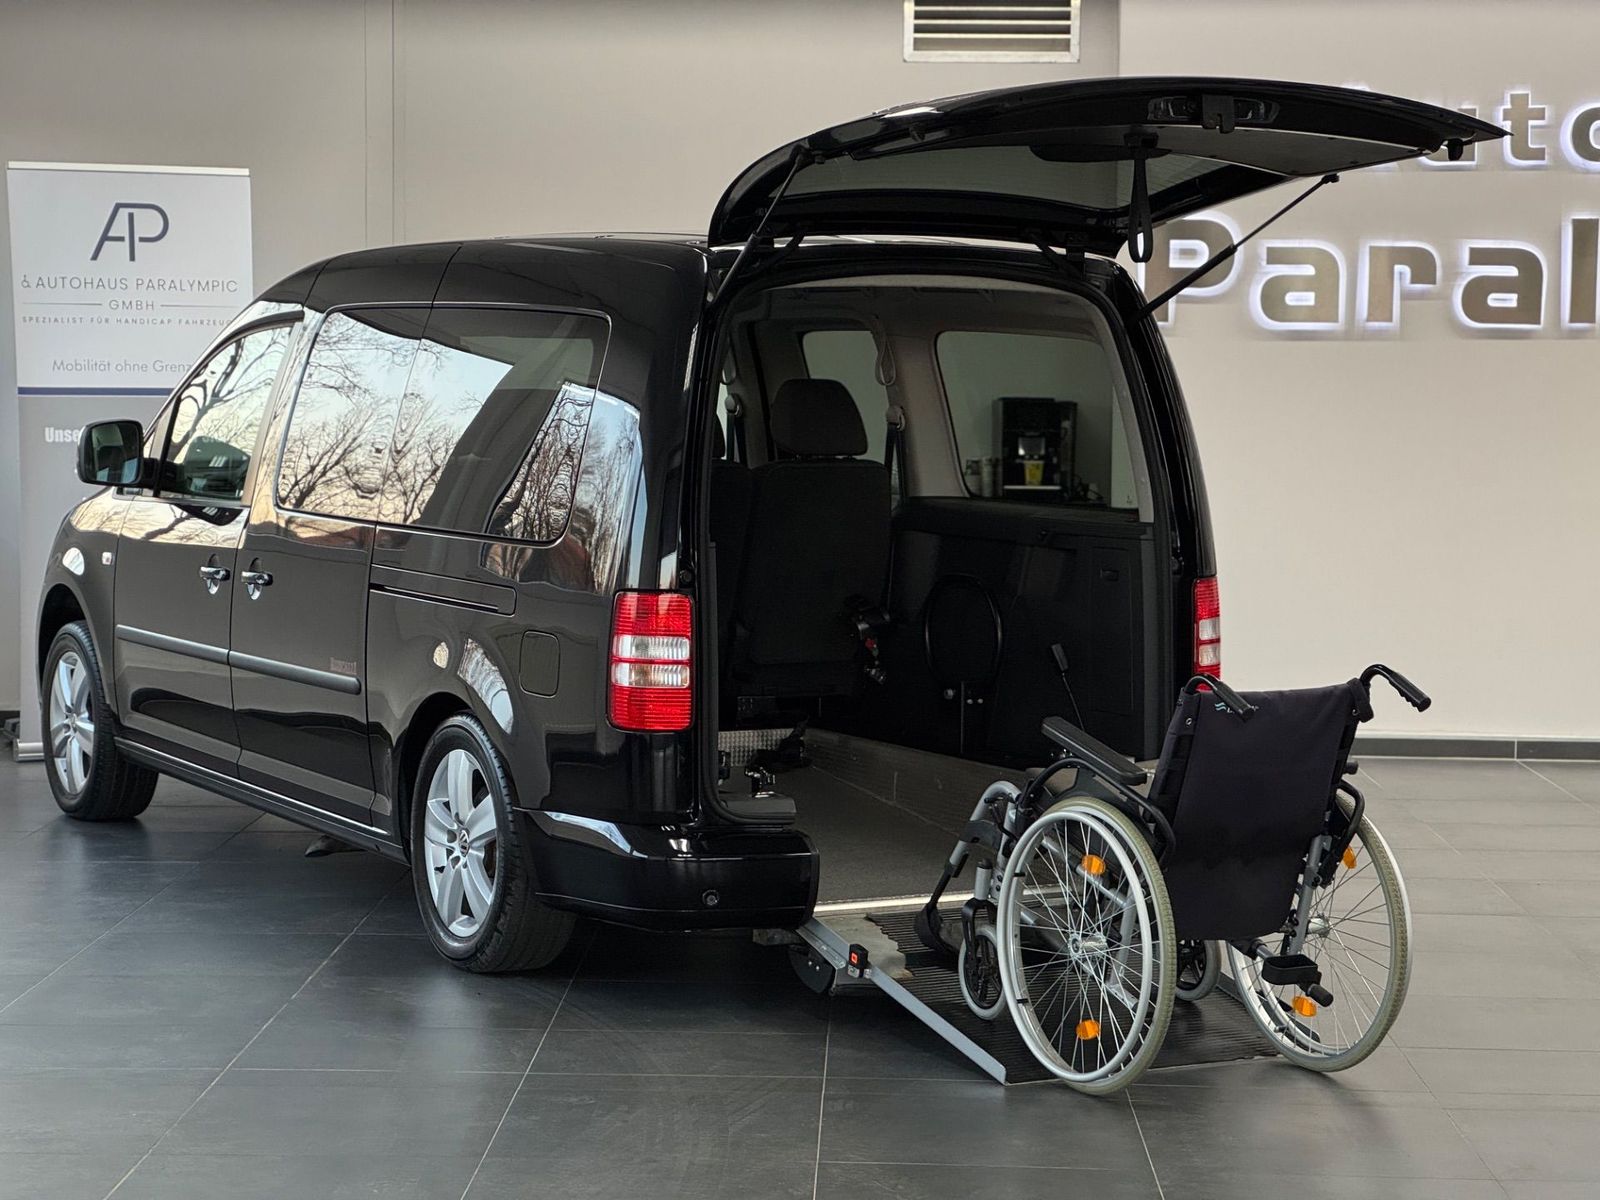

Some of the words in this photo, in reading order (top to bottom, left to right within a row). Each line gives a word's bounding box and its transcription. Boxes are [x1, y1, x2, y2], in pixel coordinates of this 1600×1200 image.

[90, 202, 169, 262] AP
[1139, 215, 1600, 324] Paral
[35, 276, 129, 290] AUTOHAUS
[136, 278, 239, 293] PARALYMPIC
[108, 300, 155, 311] GMBH
[22, 316, 84, 324] SPEZIALIST
[90, 316, 110, 324] FÜR
[116, 318, 173, 326] HANDICAP
[52, 359, 111, 372] Mobilität
[115, 359, 149, 373] ohne
